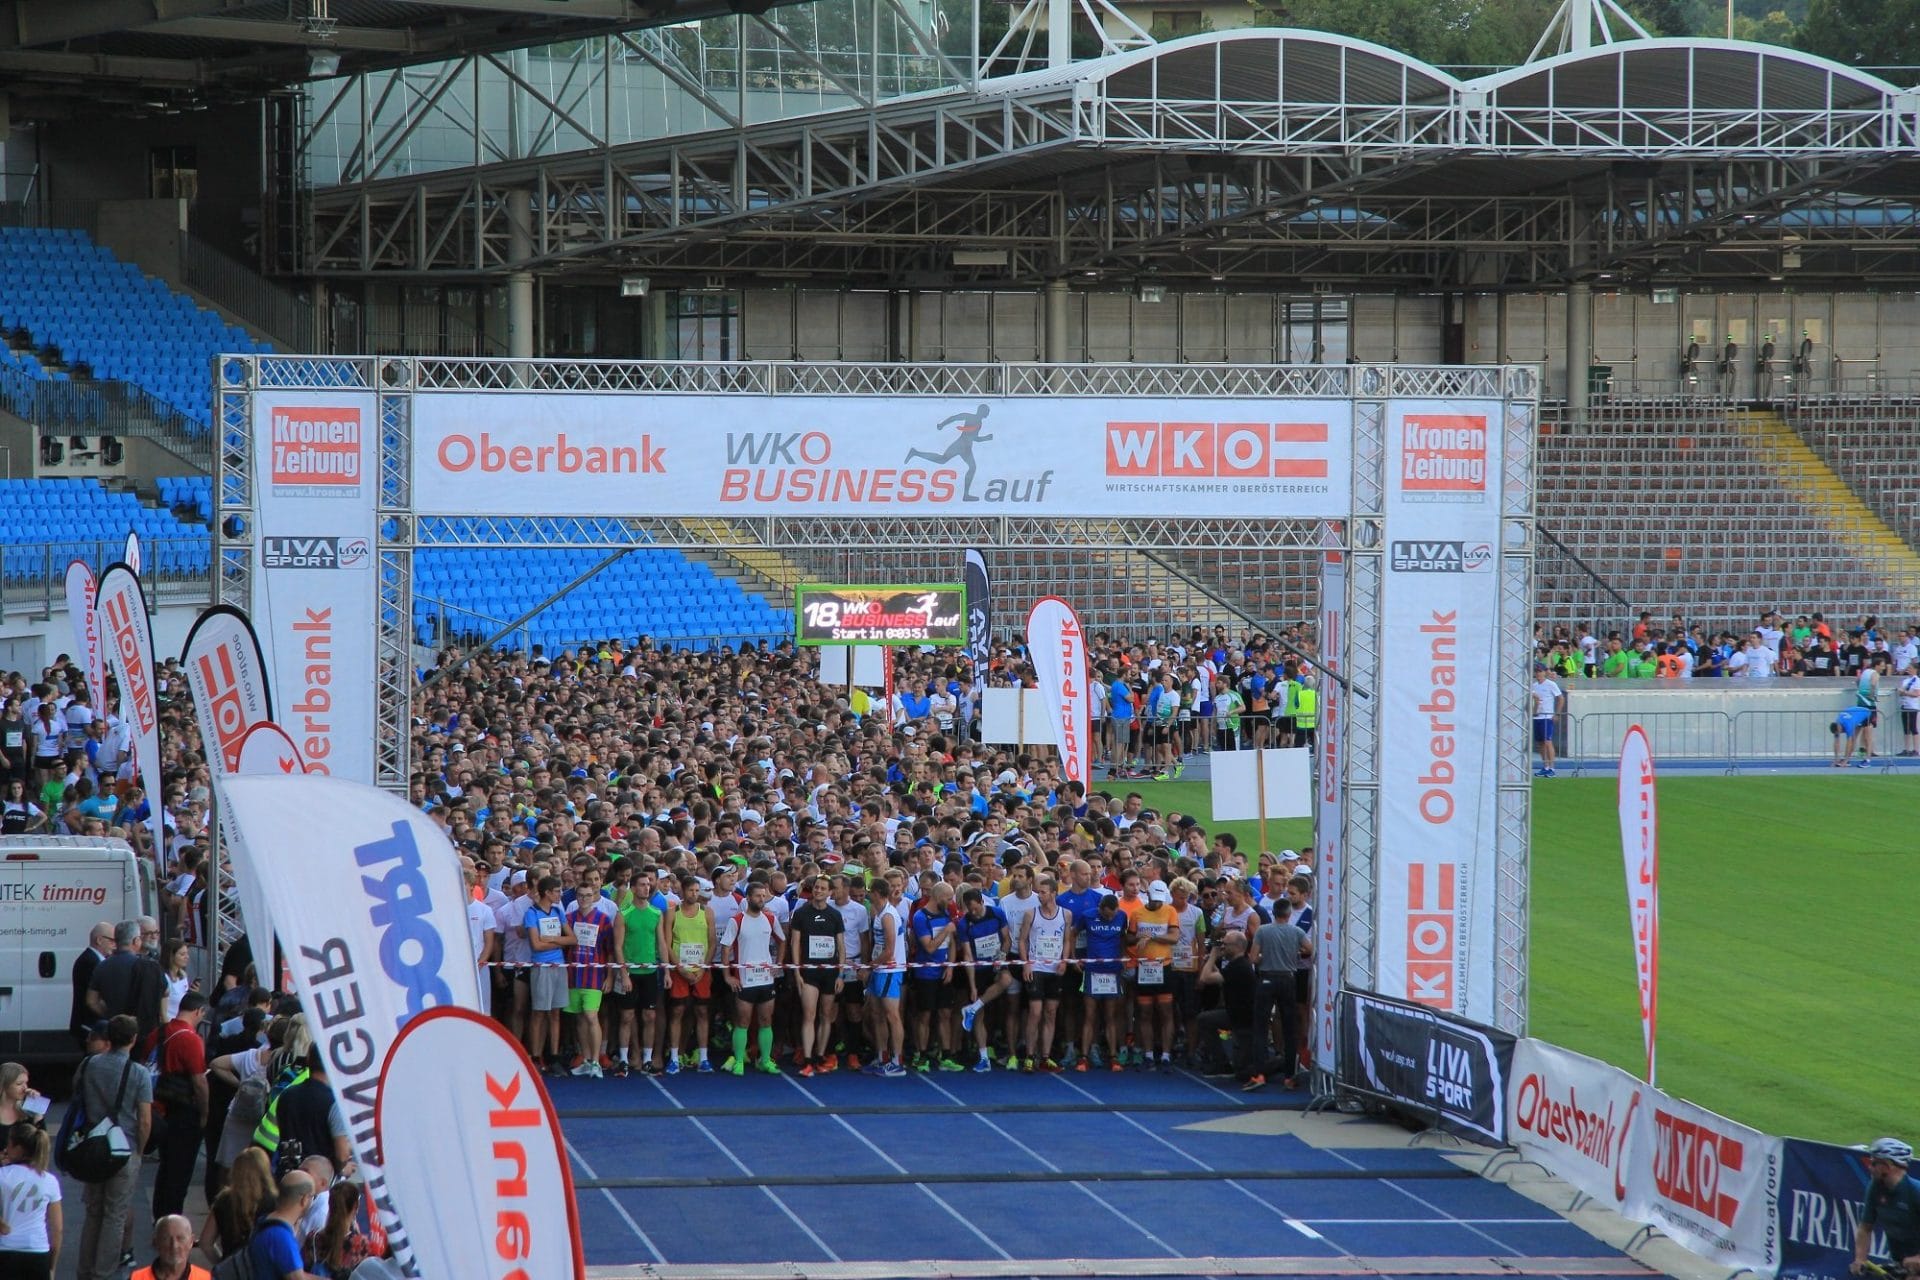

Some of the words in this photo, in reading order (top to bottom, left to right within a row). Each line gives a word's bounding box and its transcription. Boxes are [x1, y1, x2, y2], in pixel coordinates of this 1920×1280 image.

[274, 415, 358, 444] Kronen
[1404, 422, 1484, 451] Kronen
[274, 445, 358, 478] Zeitung
[437, 432, 667, 474] Oberbank
[726, 431, 831, 465] WKO
[1109, 429, 1264, 470] WKO
[1404, 451, 1484, 484] Zeitung
[719, 469, 958, 502] BUSINESS
[1105, 483, 1229, 494] WIRTSCHAFTSKAMMER
[1232, 483, 1329, 494] OBERÖSTERREICH
[265, 539, 335, 556] LIVA
[265, 556, 335, 567] SPORT
[339, 547, 369, 555] LIVA
[1394, 543, 1460, 560] LIVA
[1463, 551, 1492, 559] LIVA
[1394, 560, 1460, 570] SPORT
[804, 602, 842, 628] 18.
[843, 601, 882, 615] WKO
[841, 613, 927, 627] BUSINESS
[832, 628, 867, 639] Start
[869, 628, 883, 639] in
[1417, 609, 1457, 825] Oberbank
[0, 883, 36, 901] TEK
[42, 884, 107, 906] timing
[1427, 1038, 1472, 1088] LIVA
[1516, 1073, 1616, 1168] Oberbank
[1764, 1153, 1778, 1265] wko.at/ooe
